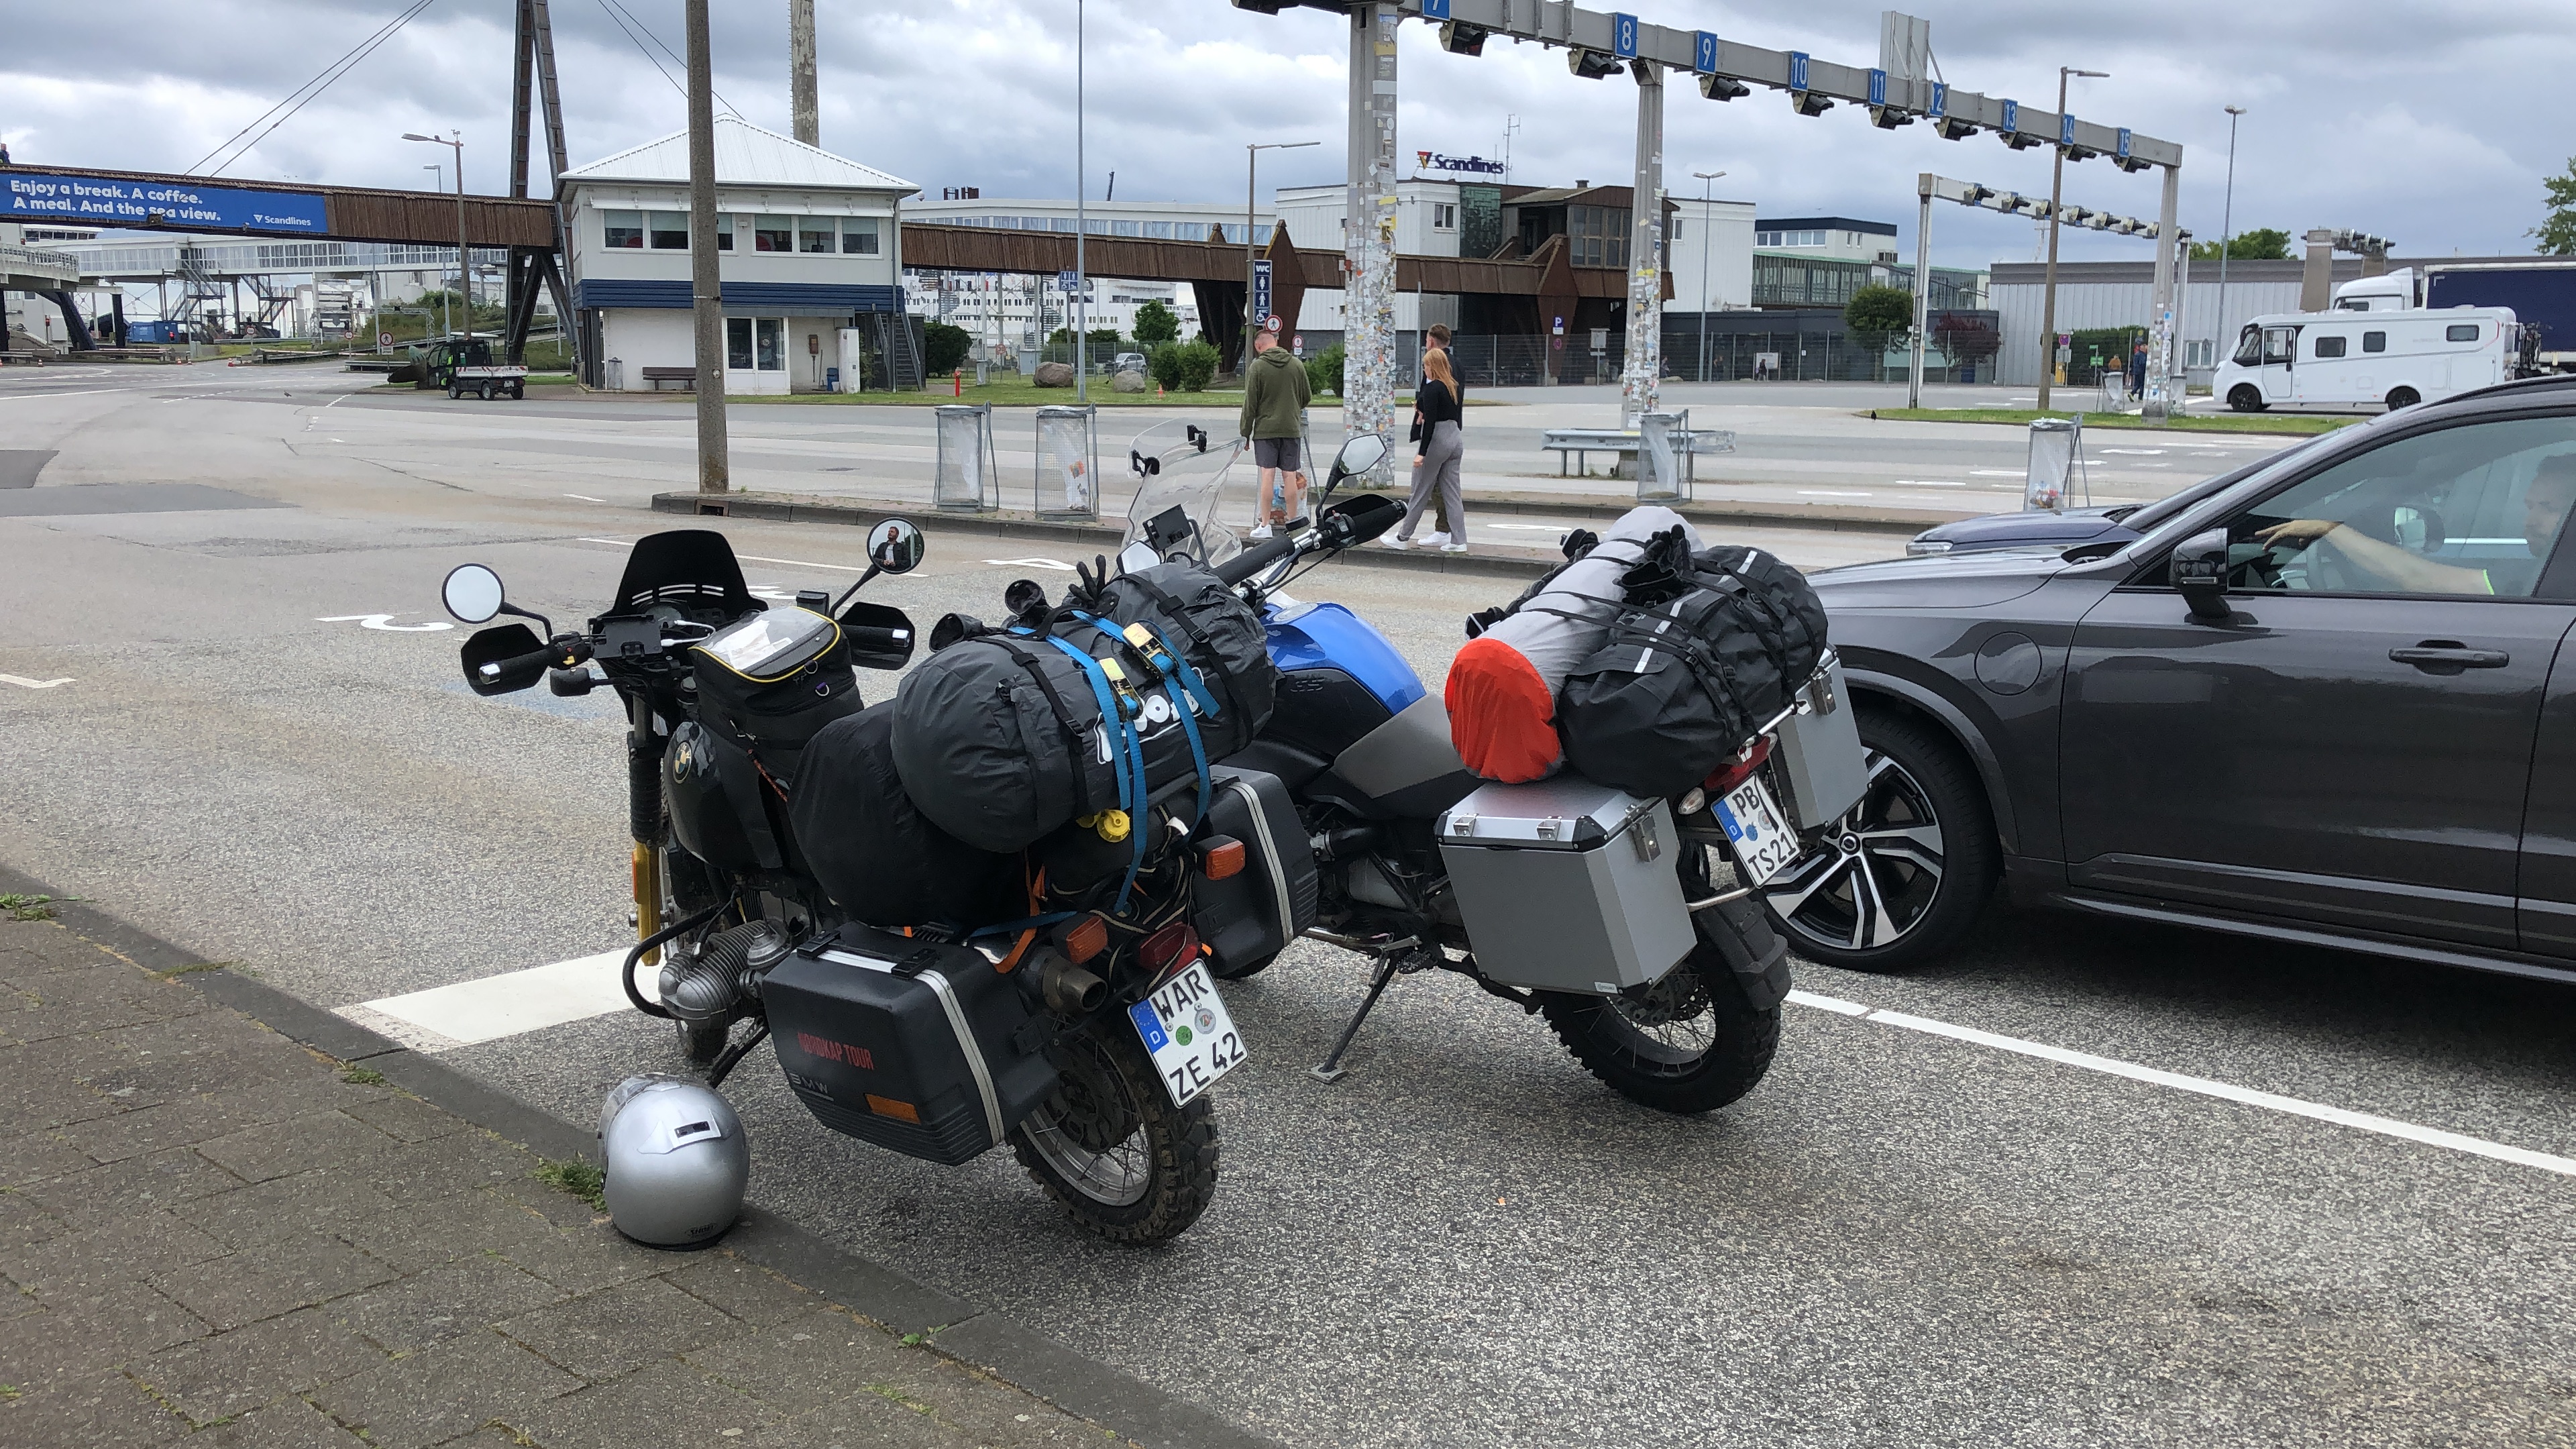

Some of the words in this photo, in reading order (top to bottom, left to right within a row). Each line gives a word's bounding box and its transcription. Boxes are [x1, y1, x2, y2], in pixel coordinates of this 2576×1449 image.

[1621, 21, 1632, 50] 8
[1703, 38, 1712, 66] 9
[1793, 57, 1807, 85] 10
[1874, 74, 1884, 101] 11
[2006, 105, 2016, 127] 13
[2063, 118, 2073, 141] 14
[2121, 132, 2130, 152] 15
[1435, 154, 1504, 174] Scandlines
[10, 180, 56, 197] Enjoy
[60, 182, 70, 195] a
[74, 182, 128, 199] break.
[131, 187, 144, 200] A
[148, 189, 203, 205] coffee.
[13, 197, 27, 209] A
[30, 199, 76, 211] meal.
[80, 200, 113, 214] And
[117, 203, 145, 216] the
[148, 206, 176, 219] sea
[179, 208, 222, 222] view.
[264, 215, 311, 226] Scandlines
[1555, 317, 1562, 327] P
[1732, 785, 1760, 818] PB
[1729, 825, 1737, 837] D
[1151, 969, 1209, 1023] WAR
[1149, 1030, 1161, 1044] D
[843, 1044, 874, 1070] TOUR
[1169, 1055, 1211, 1100] ZE
[1212, 1031, 1244, 1069] 42
